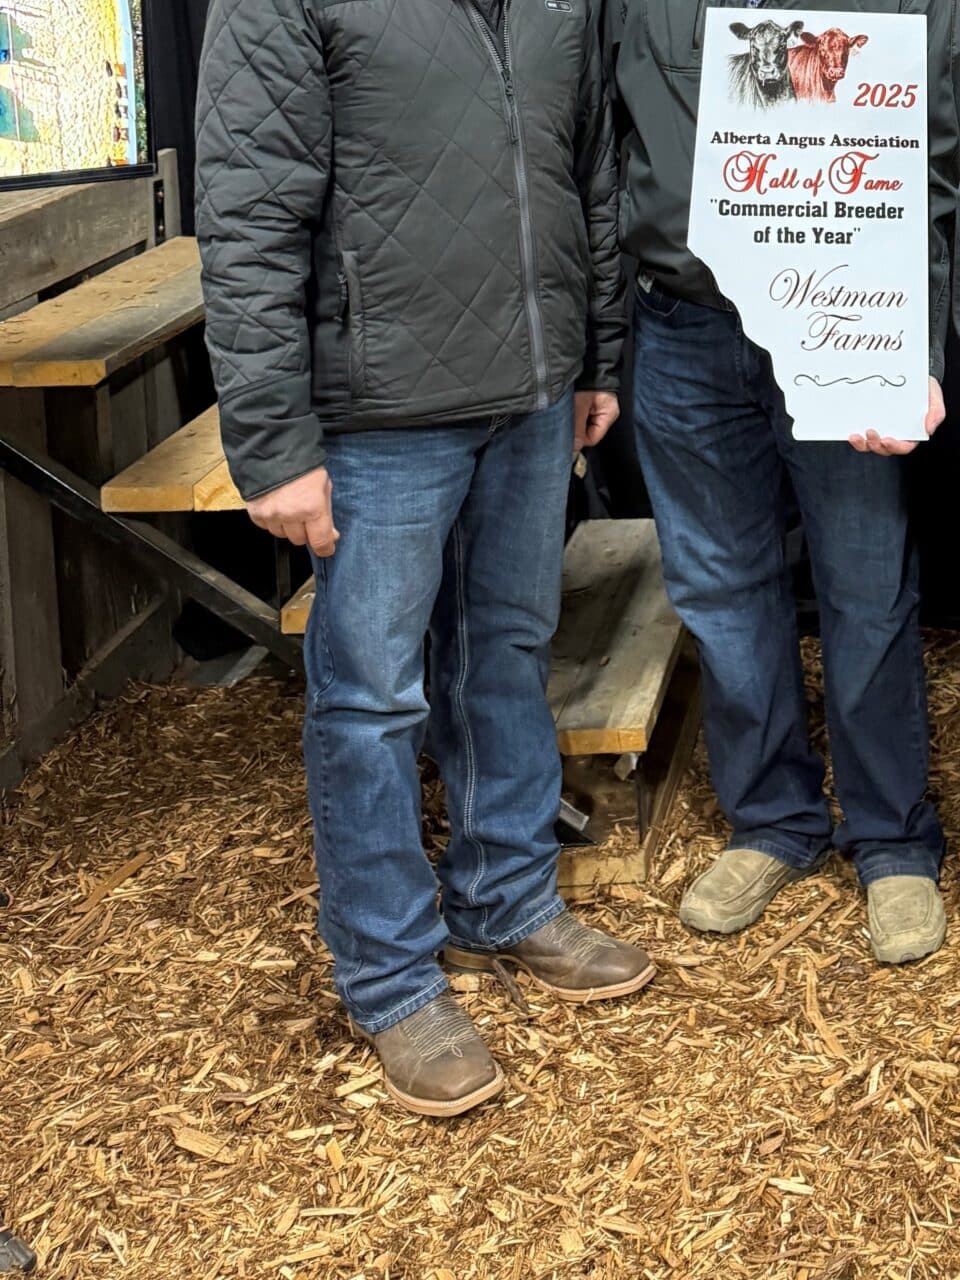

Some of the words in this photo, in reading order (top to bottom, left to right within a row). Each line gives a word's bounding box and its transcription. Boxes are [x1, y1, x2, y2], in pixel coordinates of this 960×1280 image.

[853, 83, 919, 109] 2025
[710, 131, 771, 146] Alberta
[776, 133, 825, 149] Angus
[829, 134, 920, 149] Association
[723, 150, 799, 195] Hall
[802, 168, 825, 197] of
[828, 151, 903, 195] Fame
[834, 201, 905, 219] Breeder
[753, 226, 773, 244] of
[777, 227, 806, 243] the
[769, 264, 908, 310] Westman
[800, 311, 904, 352] Farms
